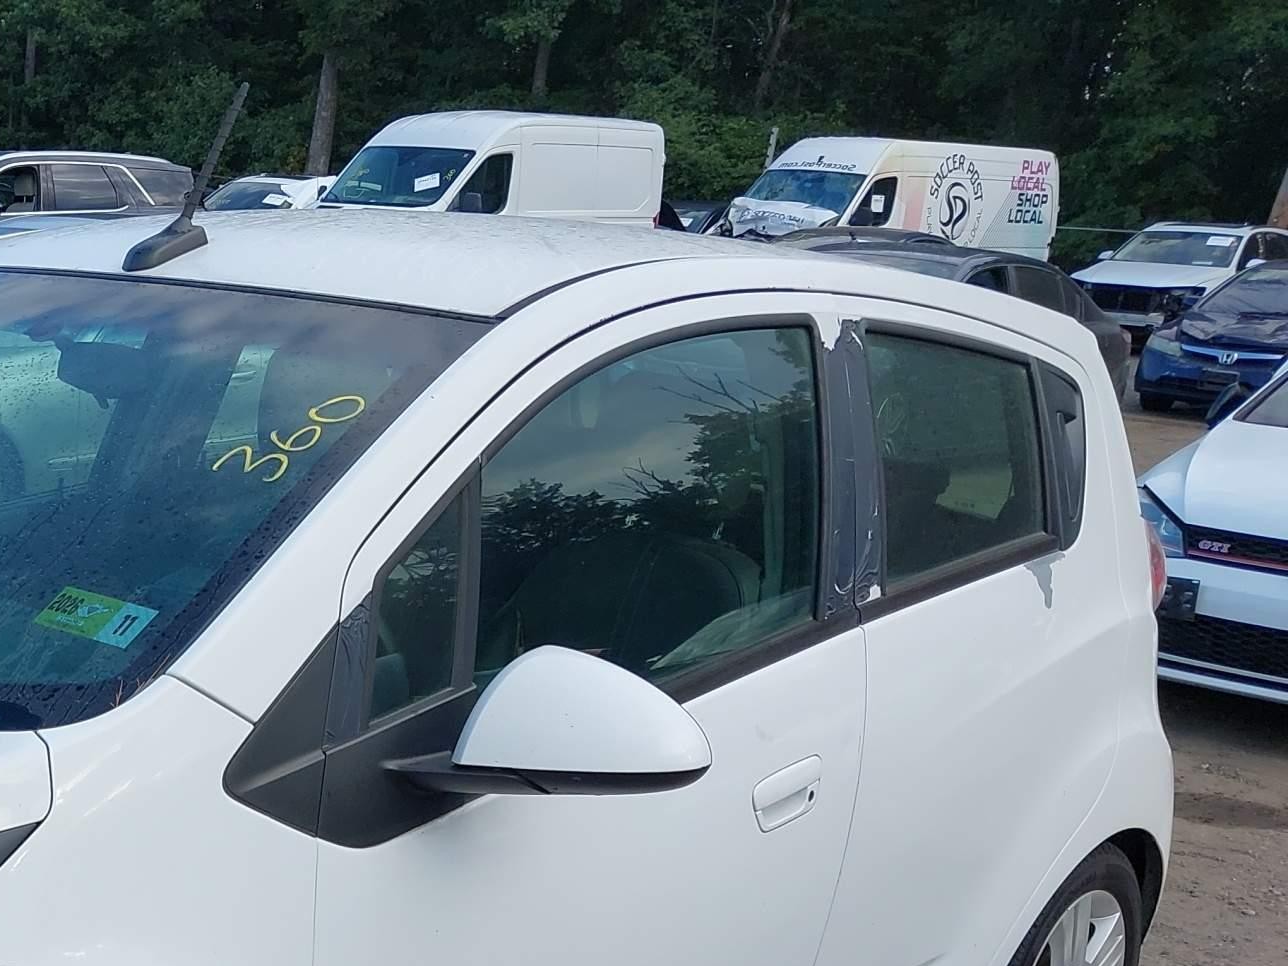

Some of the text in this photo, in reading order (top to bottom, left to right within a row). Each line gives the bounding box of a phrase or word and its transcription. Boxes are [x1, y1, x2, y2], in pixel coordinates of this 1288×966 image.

[1022, 159, 1051, 176] PLAY
[929, 153, 984, 202] SOCCER POST
[1010, 175, 1047, 192] LOCAL
[1016, 192, 1049, 209] SHOP
[1007, 208, 1044, 225] LOCAL
[211, 394, 366, 483] 360
[1198, 540, 1231, 553] GTI
[47, 592, 86, 616] 2026
[112, 613, 139, 637] 11
